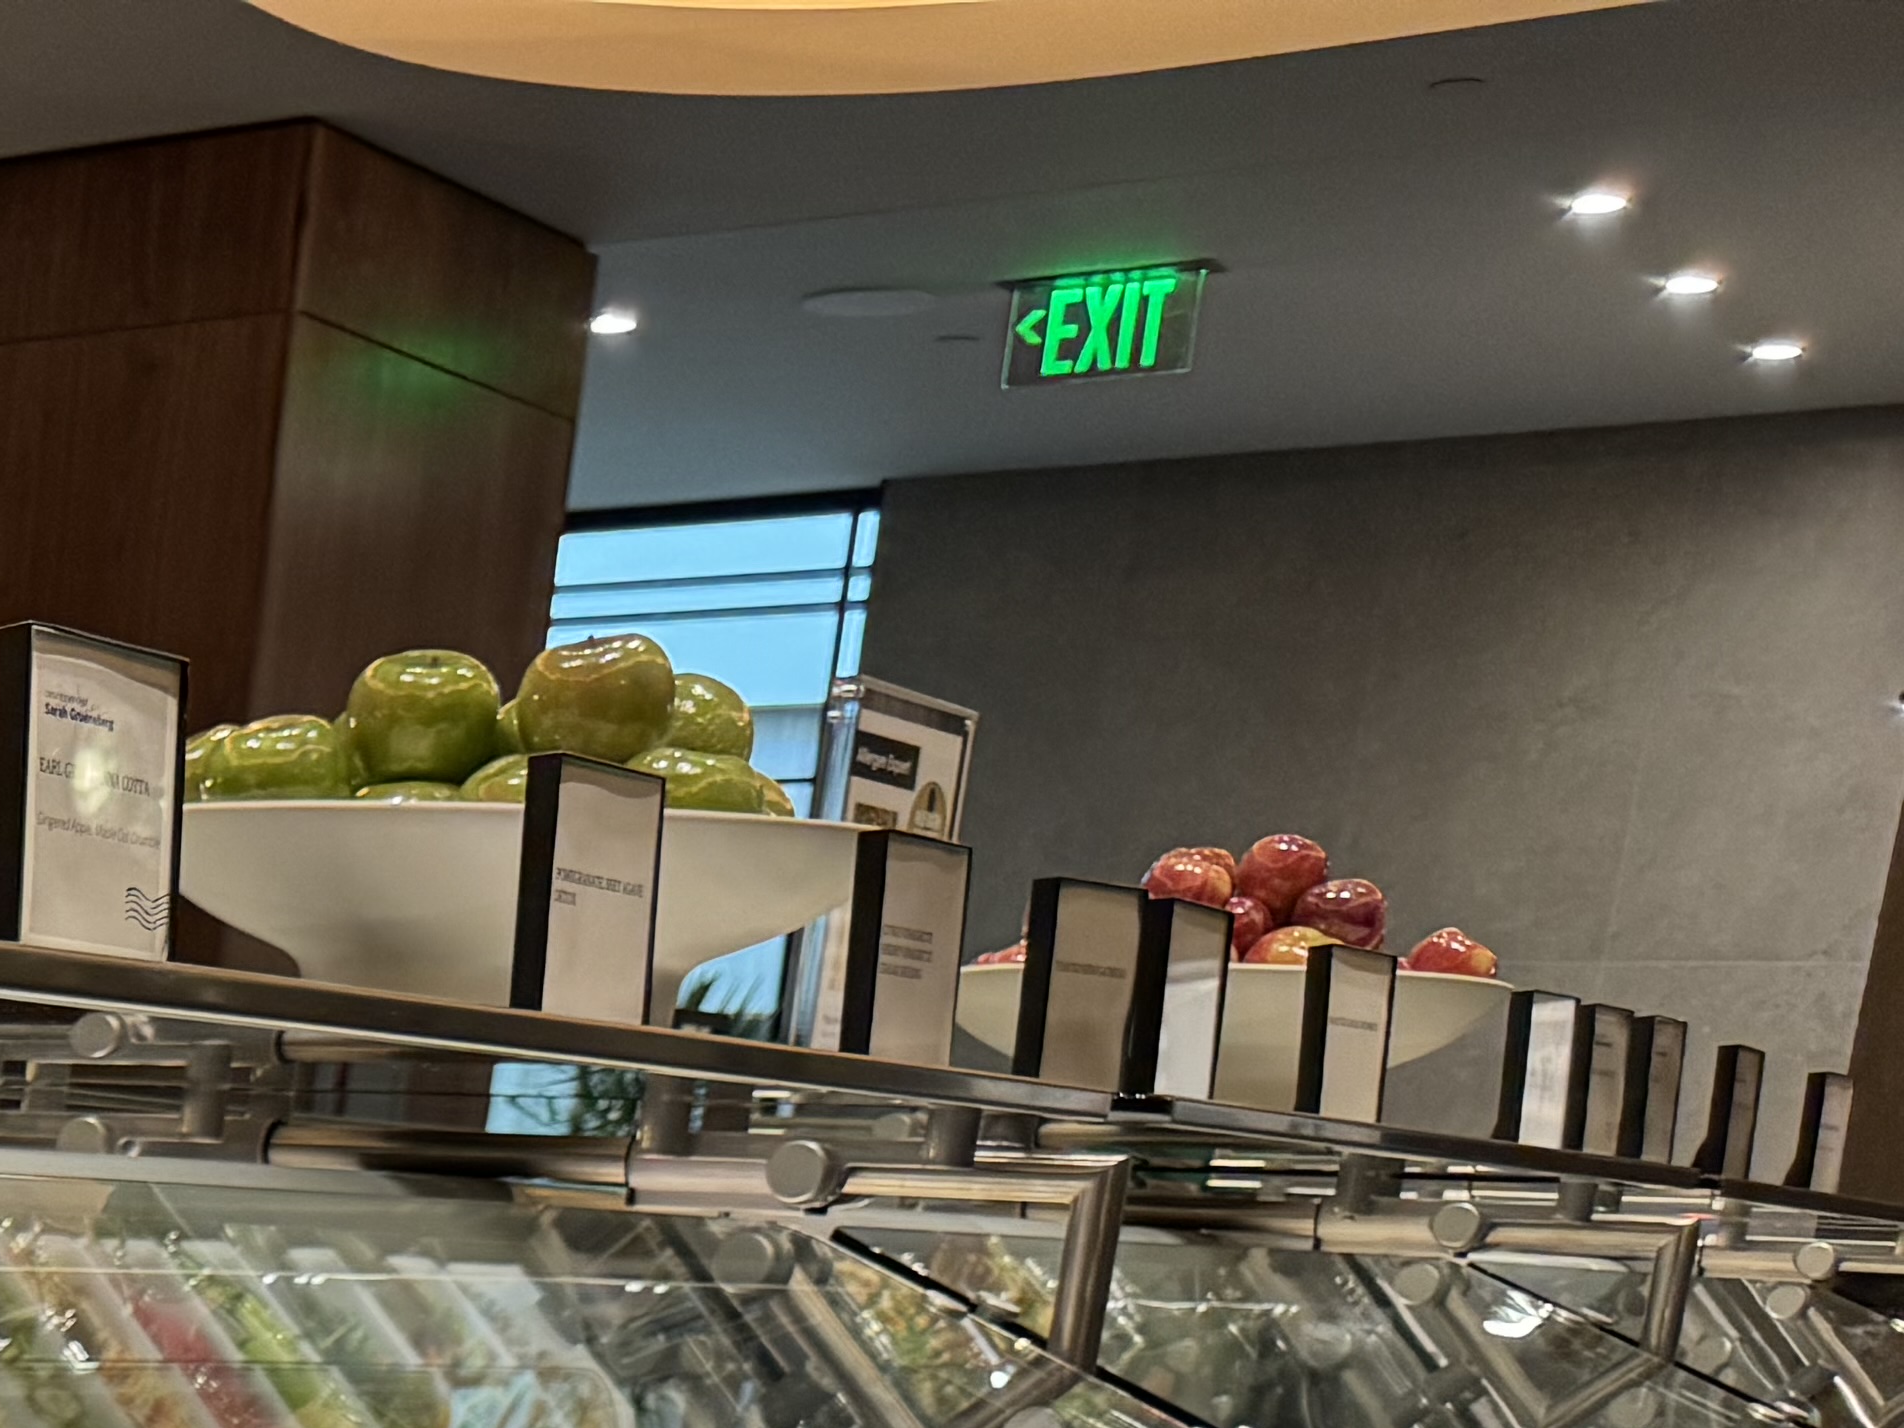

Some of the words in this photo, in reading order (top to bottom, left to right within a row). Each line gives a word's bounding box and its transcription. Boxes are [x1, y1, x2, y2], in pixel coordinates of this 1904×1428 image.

[1040, 277, 1177, 377] EXIT
[44, 701, 68, 719] Sarah
[39, 757, 63, 777] EARL
